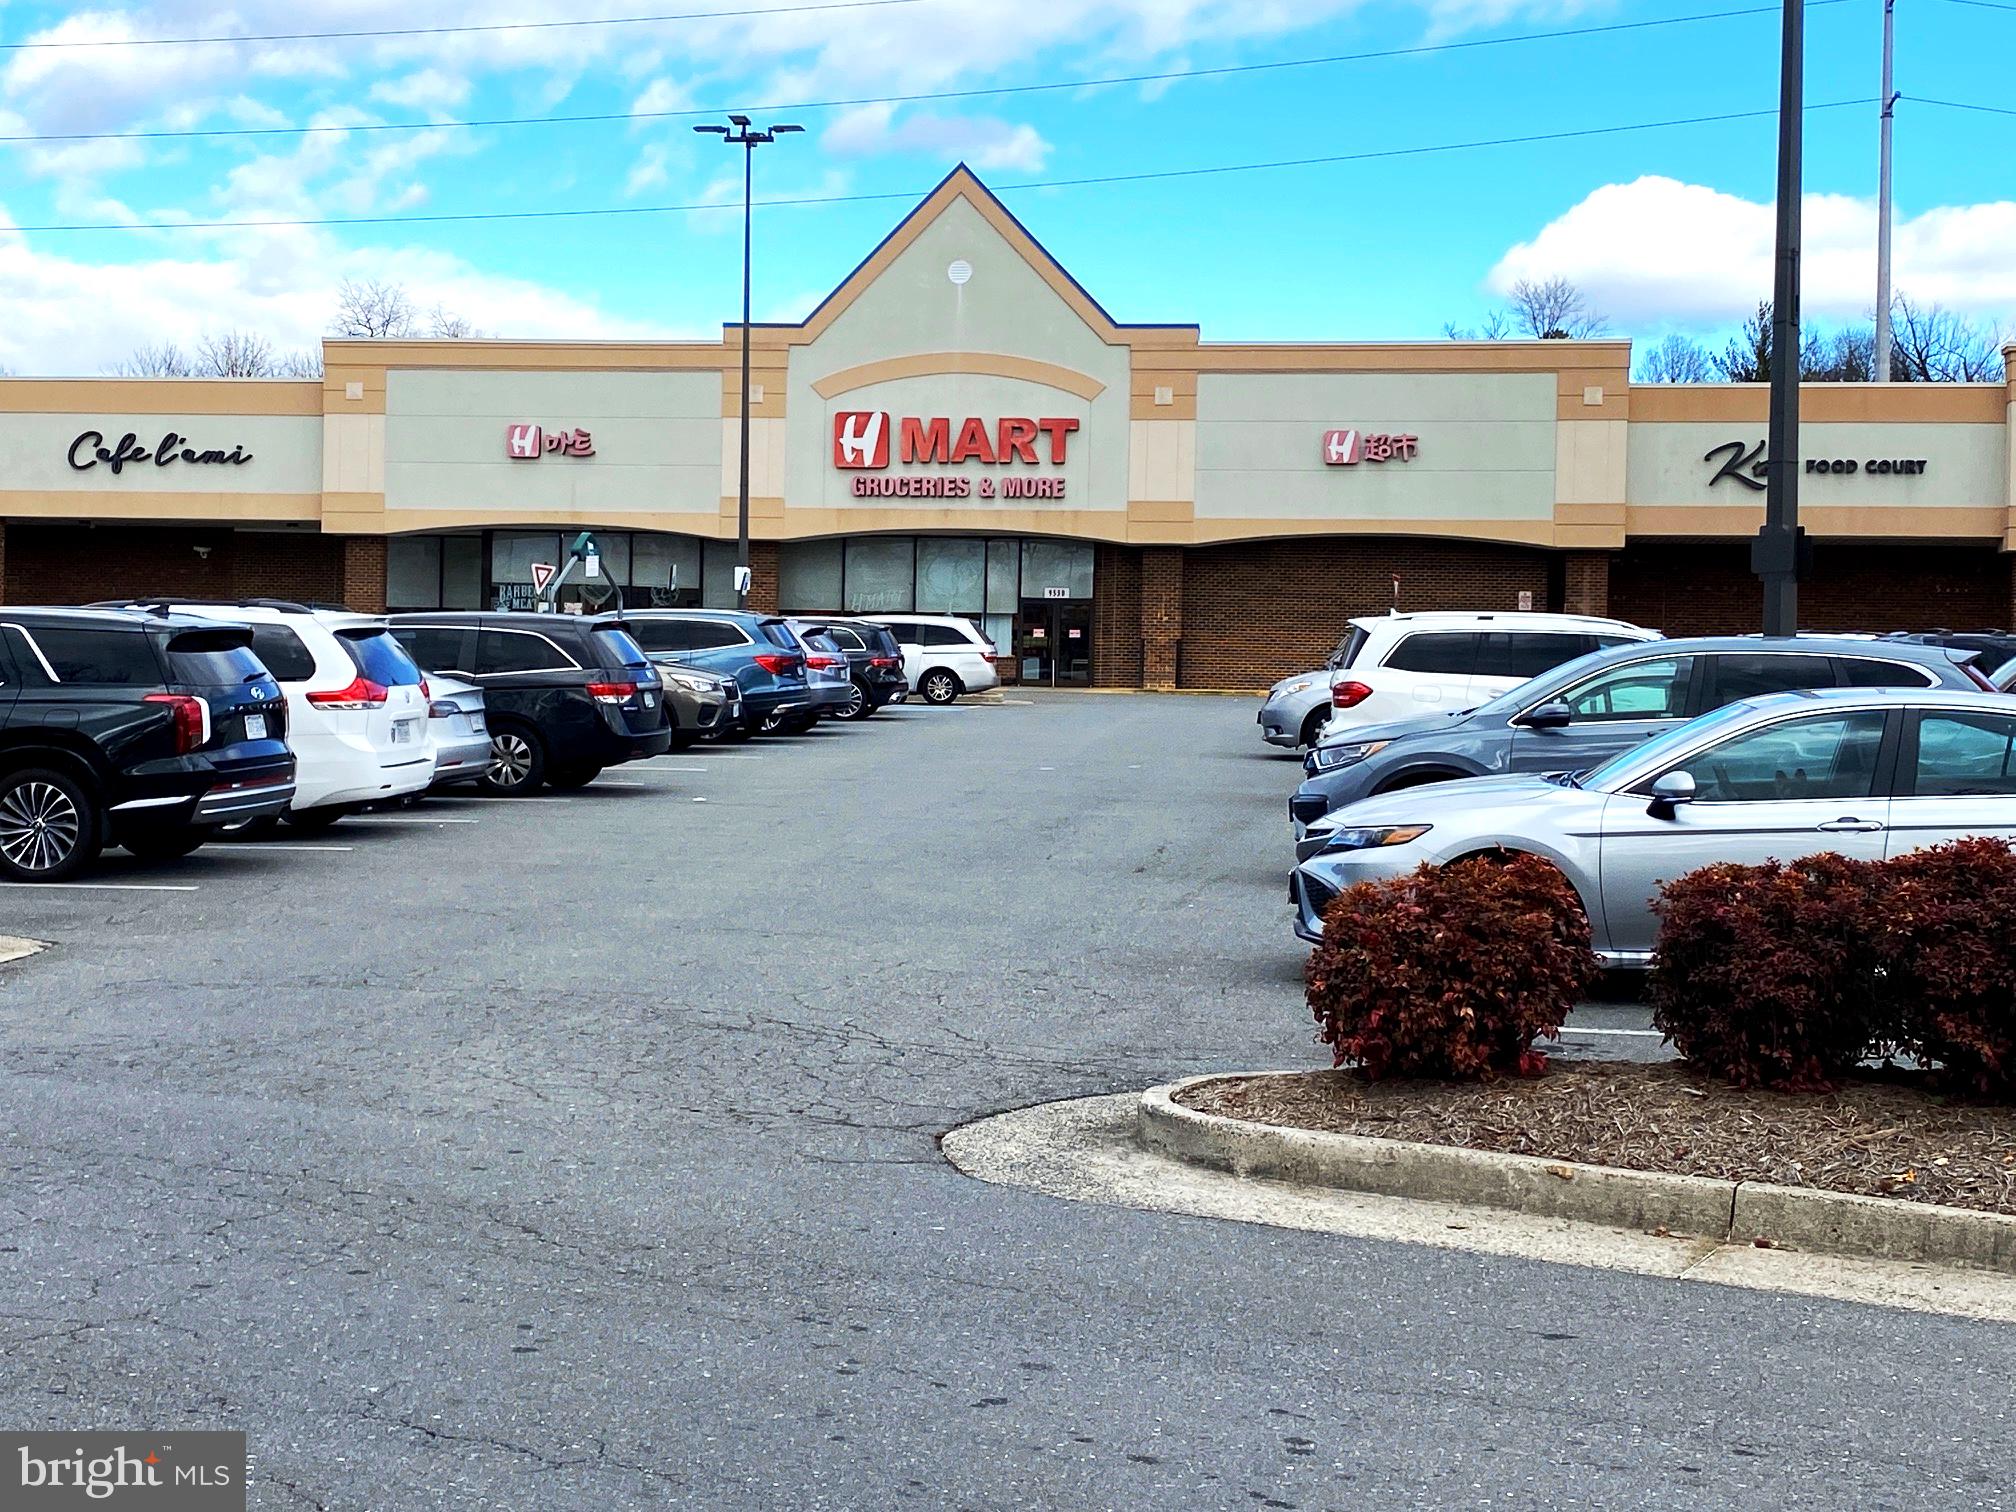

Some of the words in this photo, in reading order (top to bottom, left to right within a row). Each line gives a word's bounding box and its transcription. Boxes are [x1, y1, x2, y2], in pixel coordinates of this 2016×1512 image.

[68, 431, 152, 475] Cafe
[543, 428, 596, 457] 마트
[838, 411, 883, 467] H
[901, 417, 1080, 464] MART
[1364, 433, 1419, 462] 超市
[1805, 459, 1858, 475] FOOD
[1865, 459, 1928, 475] COURT
[852, 475, 970, 498] GROCERIES
[978, 475, 996, 499] &
[1002, 477, 1066, 498] MORE
